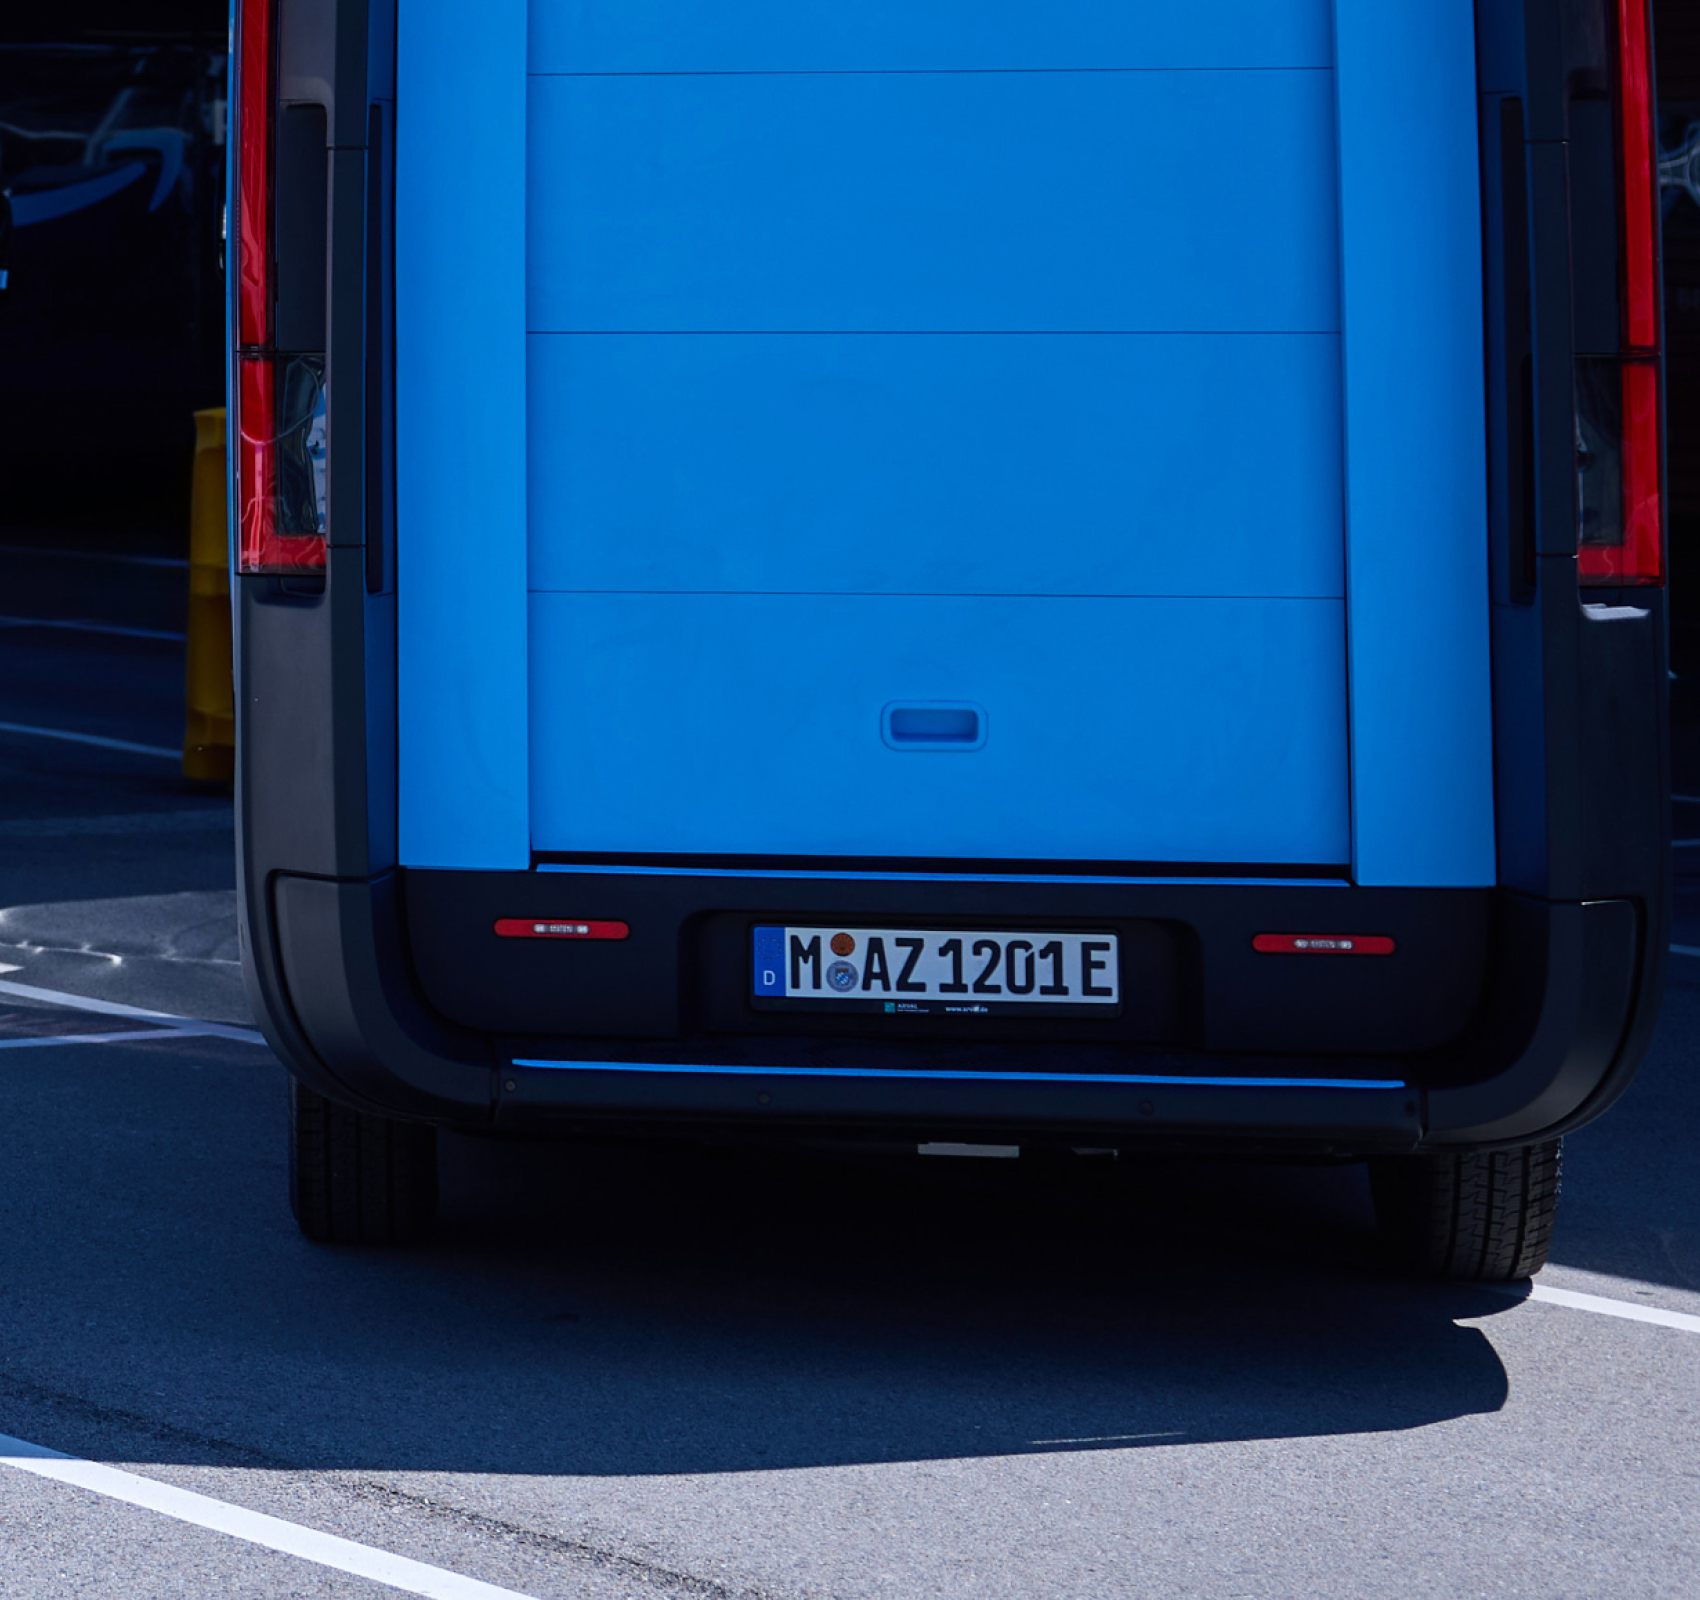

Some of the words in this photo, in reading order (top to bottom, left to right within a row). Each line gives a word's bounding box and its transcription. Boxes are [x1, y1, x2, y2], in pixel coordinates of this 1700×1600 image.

[763, 970, 775, 985] D
[790, 935, 821, 990] M
[862, 937, 927, 993] AZ
